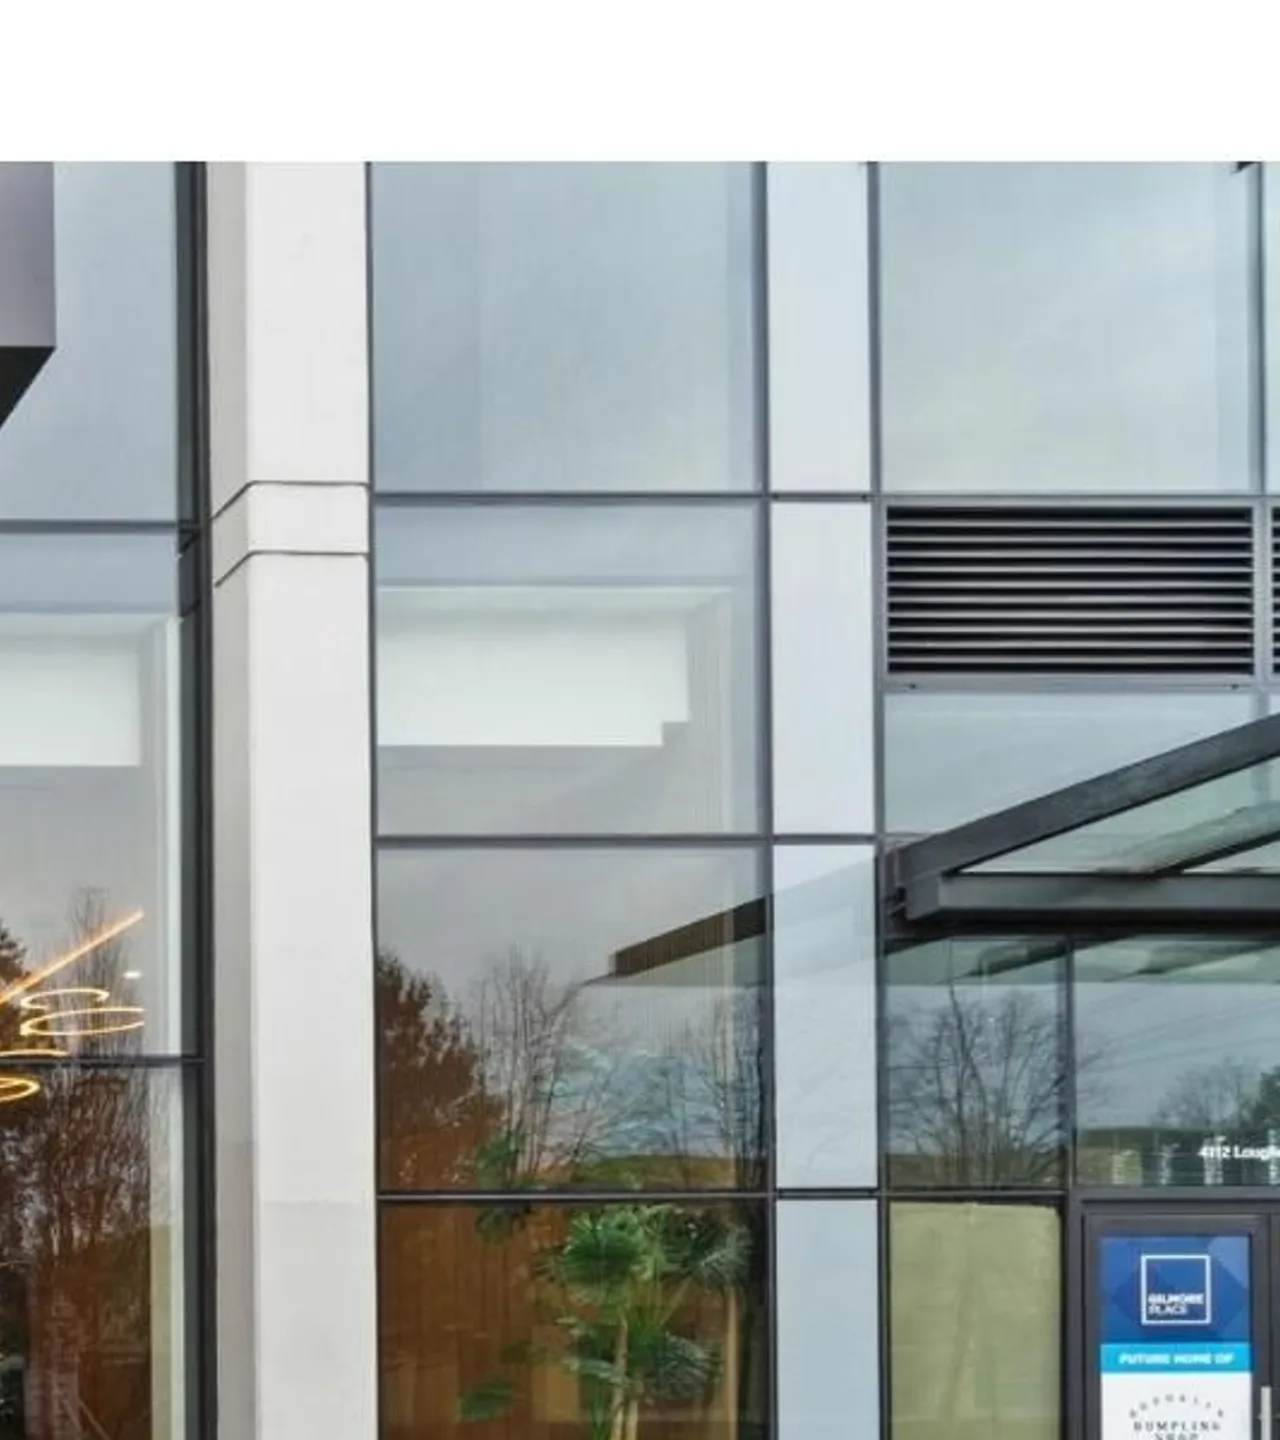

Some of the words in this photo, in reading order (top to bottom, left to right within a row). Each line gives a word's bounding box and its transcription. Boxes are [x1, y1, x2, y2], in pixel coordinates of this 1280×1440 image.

[1148, 1293, 1204, 1304] GILMORE
[1148, 1304, 1188, 1315] PLACE
[1119, 1353, 1170, 1365] FUTURE
[1173, 1353, 1212, 1365] HOME
[1214, 1353, 1236, 1365] OF
[1133, 1420, 1221, 1432] DUMPLING
